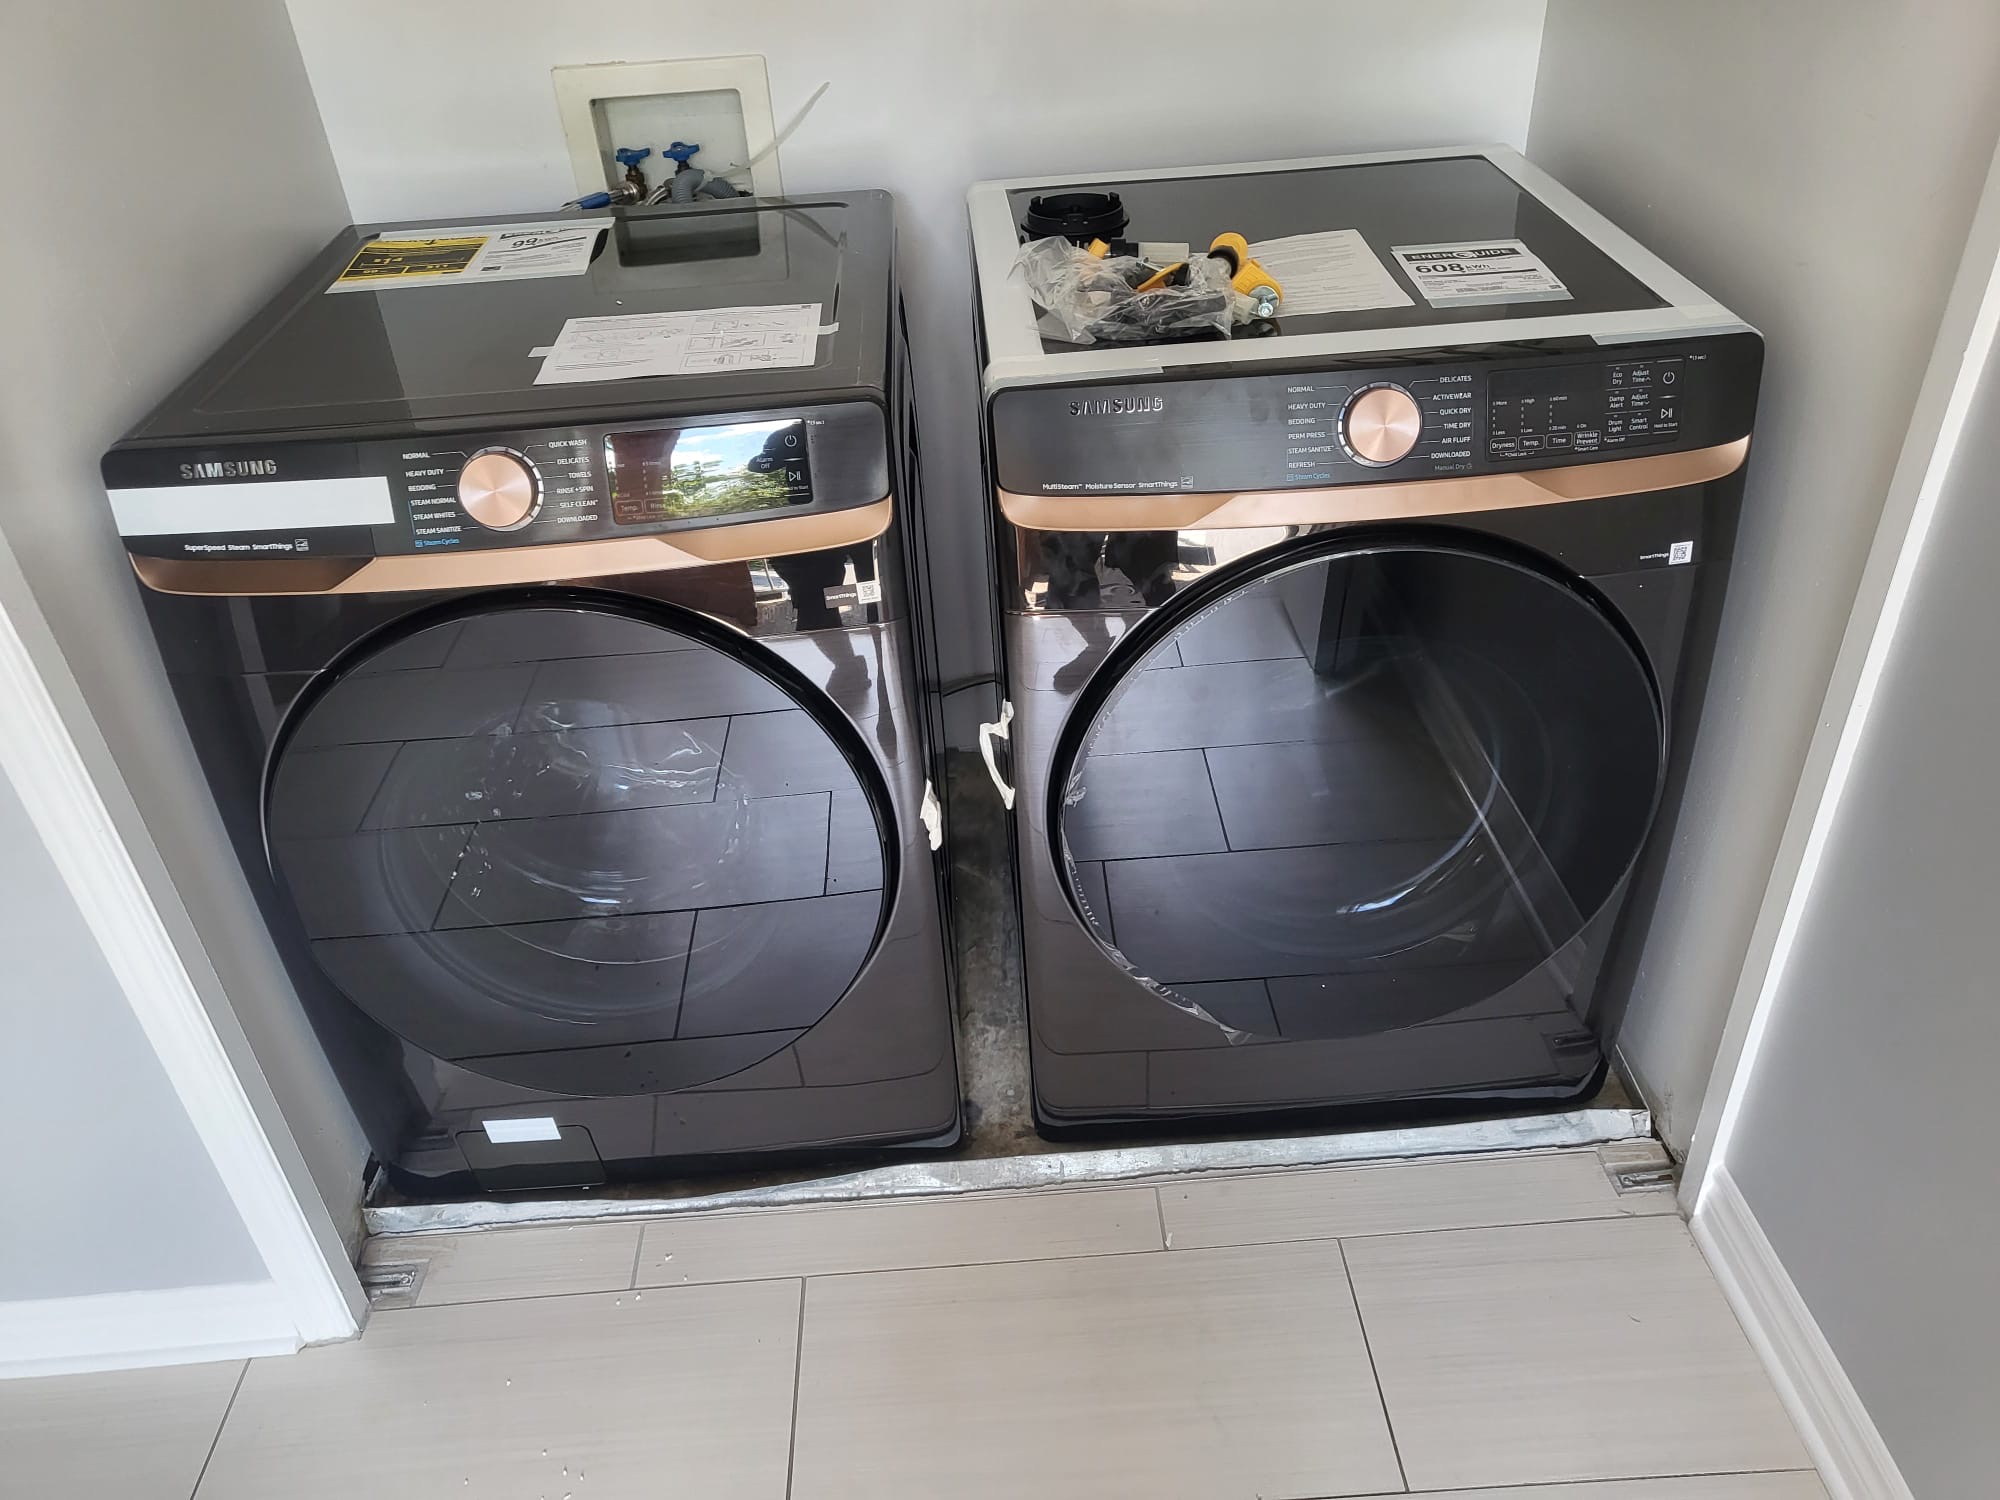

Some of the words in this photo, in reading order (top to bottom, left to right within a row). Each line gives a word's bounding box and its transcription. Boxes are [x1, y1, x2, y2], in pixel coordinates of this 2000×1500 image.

[512, 238, 538, 248] 99
[1415, 263, 1464, 273] 608
[1440, 375, 1472, 383] DELICATES
[1432, 392, 1472, 400] ACTIVEWEAR
[1069, 396, 1163, 416] SAMSUNG
[548, 440, 568, 448] QUICK
[1431, 451, 1471, 459] DOWNLOADED
[557, 456, 590, 464] DELICATES
[180, 460, 277, 480] SAMSUNG
[1138, 480, 1178, 488] SmartThings
[558, 514, 598, 524] DOWNLOADED
[184, 544, 226, 552] SuperSpeed
[252, 543, 293, 551] SmartThings
